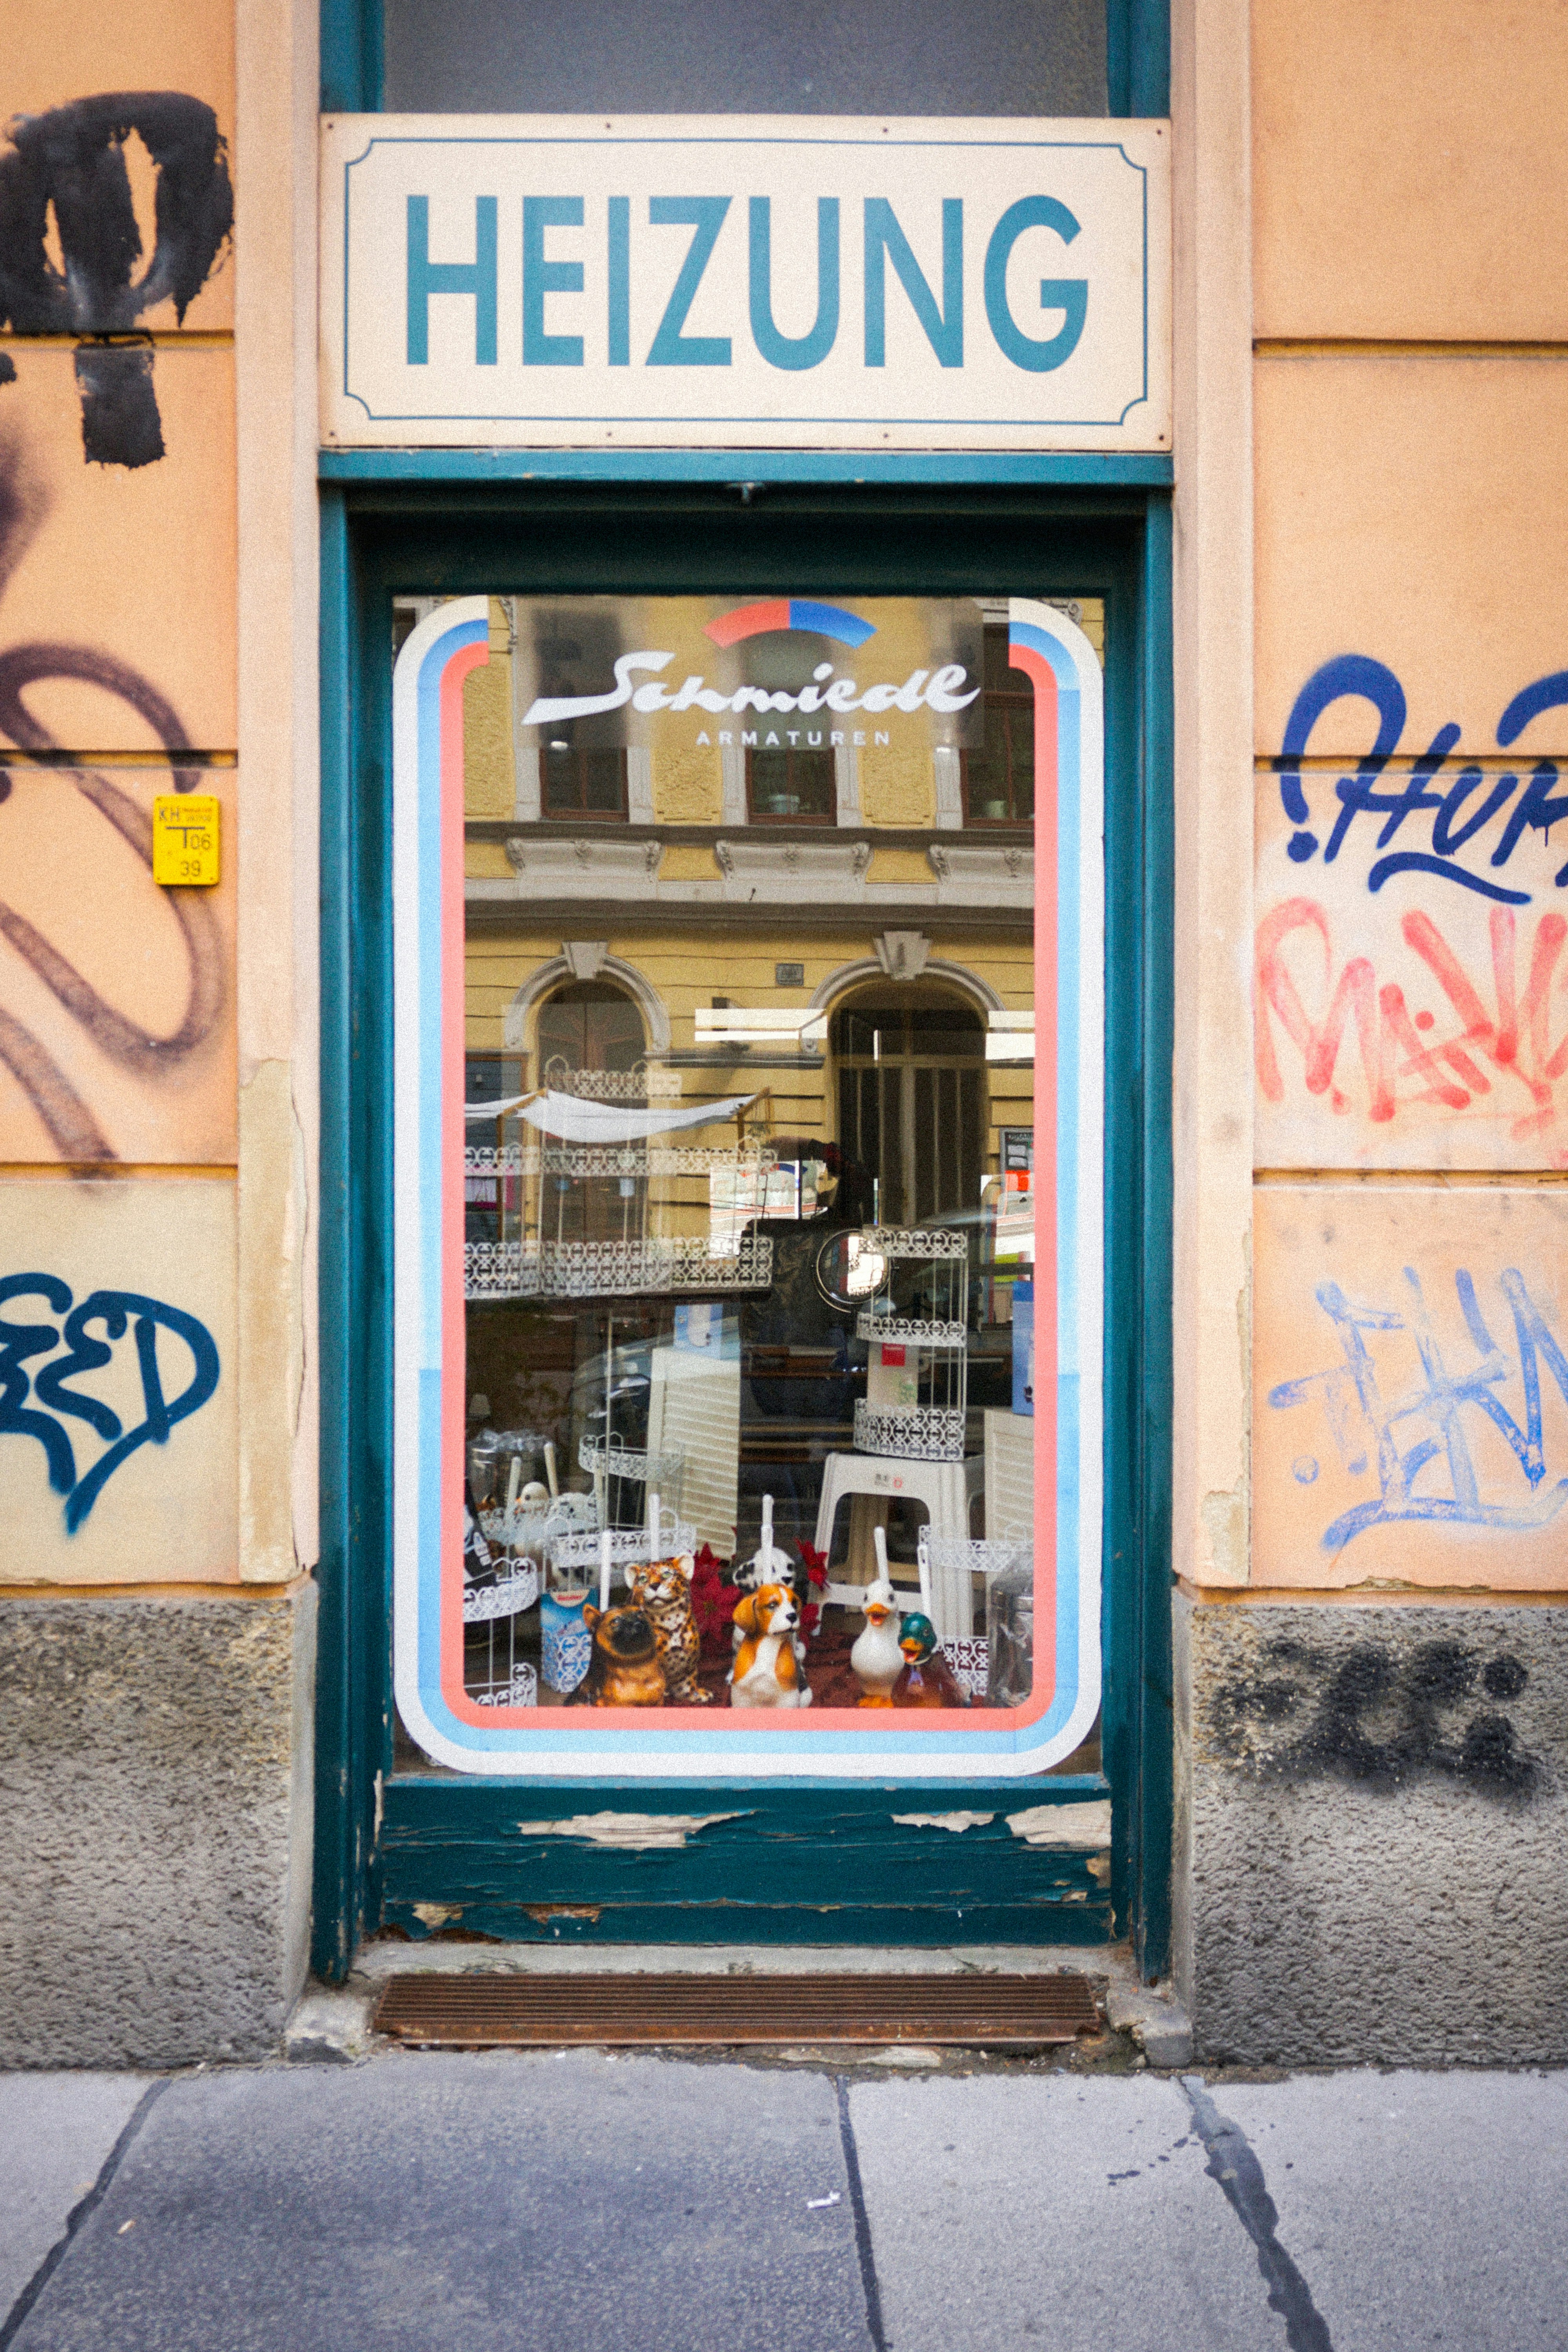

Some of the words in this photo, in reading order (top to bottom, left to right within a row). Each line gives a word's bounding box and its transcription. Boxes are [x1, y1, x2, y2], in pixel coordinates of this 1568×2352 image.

[407, 194, 1089, 372] HEIZUNG
[522, 650, 981, 724] Schmiedl
[696, 731, 889, 746] ARMATUREN
[159, 806, 179, 822] KH
[181, 860, 200, 877] 39
